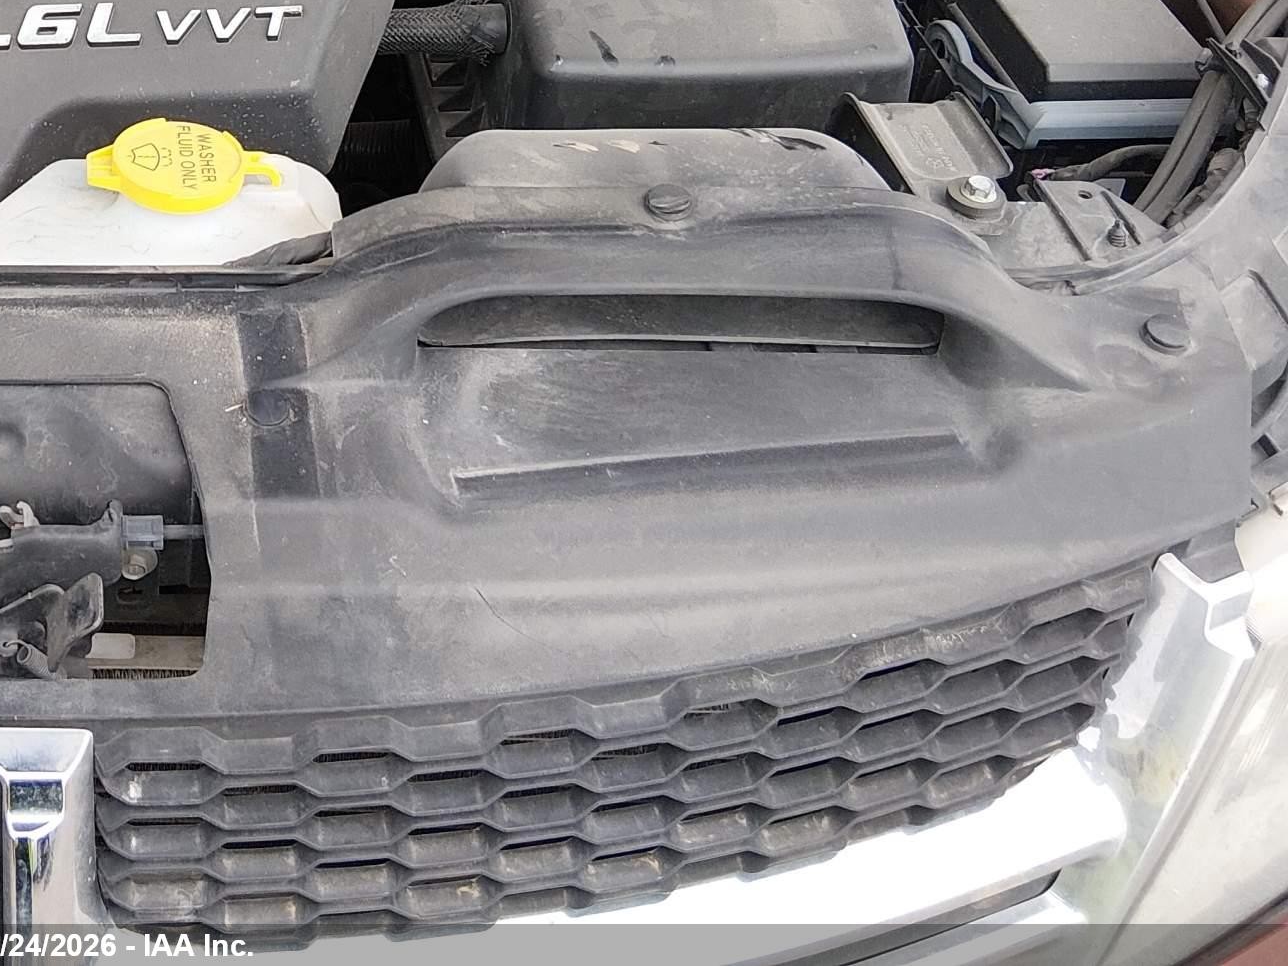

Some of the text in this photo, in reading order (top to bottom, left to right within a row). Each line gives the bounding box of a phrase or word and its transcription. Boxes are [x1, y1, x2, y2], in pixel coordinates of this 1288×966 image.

[155, 4, 304, 46] VVT
[176, 125, 199, 191] FLUID ONLY
[196, 133, 217, 183] WASHER
